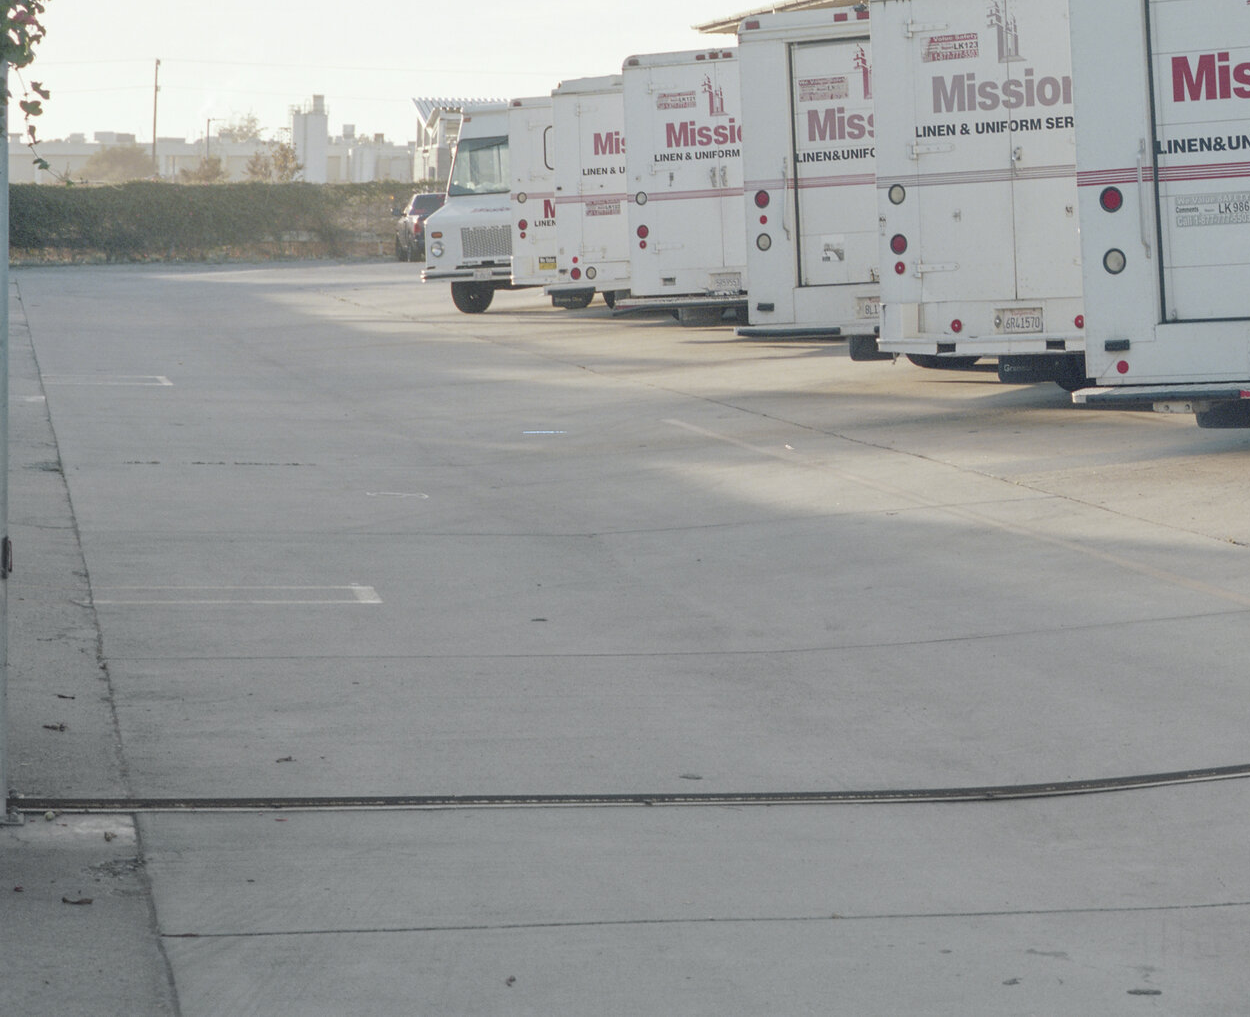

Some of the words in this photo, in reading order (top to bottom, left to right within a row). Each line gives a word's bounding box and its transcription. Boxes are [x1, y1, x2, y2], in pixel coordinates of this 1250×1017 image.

[915, 124, 956, 138] LINEN
[959, 123, 971, 135] &
[975, 118, 1042, 134] UNIFORM
[654, 153, 683, 162] LINEN
[685, 152, 692, 160] &
[694, 149, 740, 160] UNIFORM
[582, 167, 608, 176] LINEN
[609, 166, 617, 174] &
[1175, 206, 1199, 214] Comments
